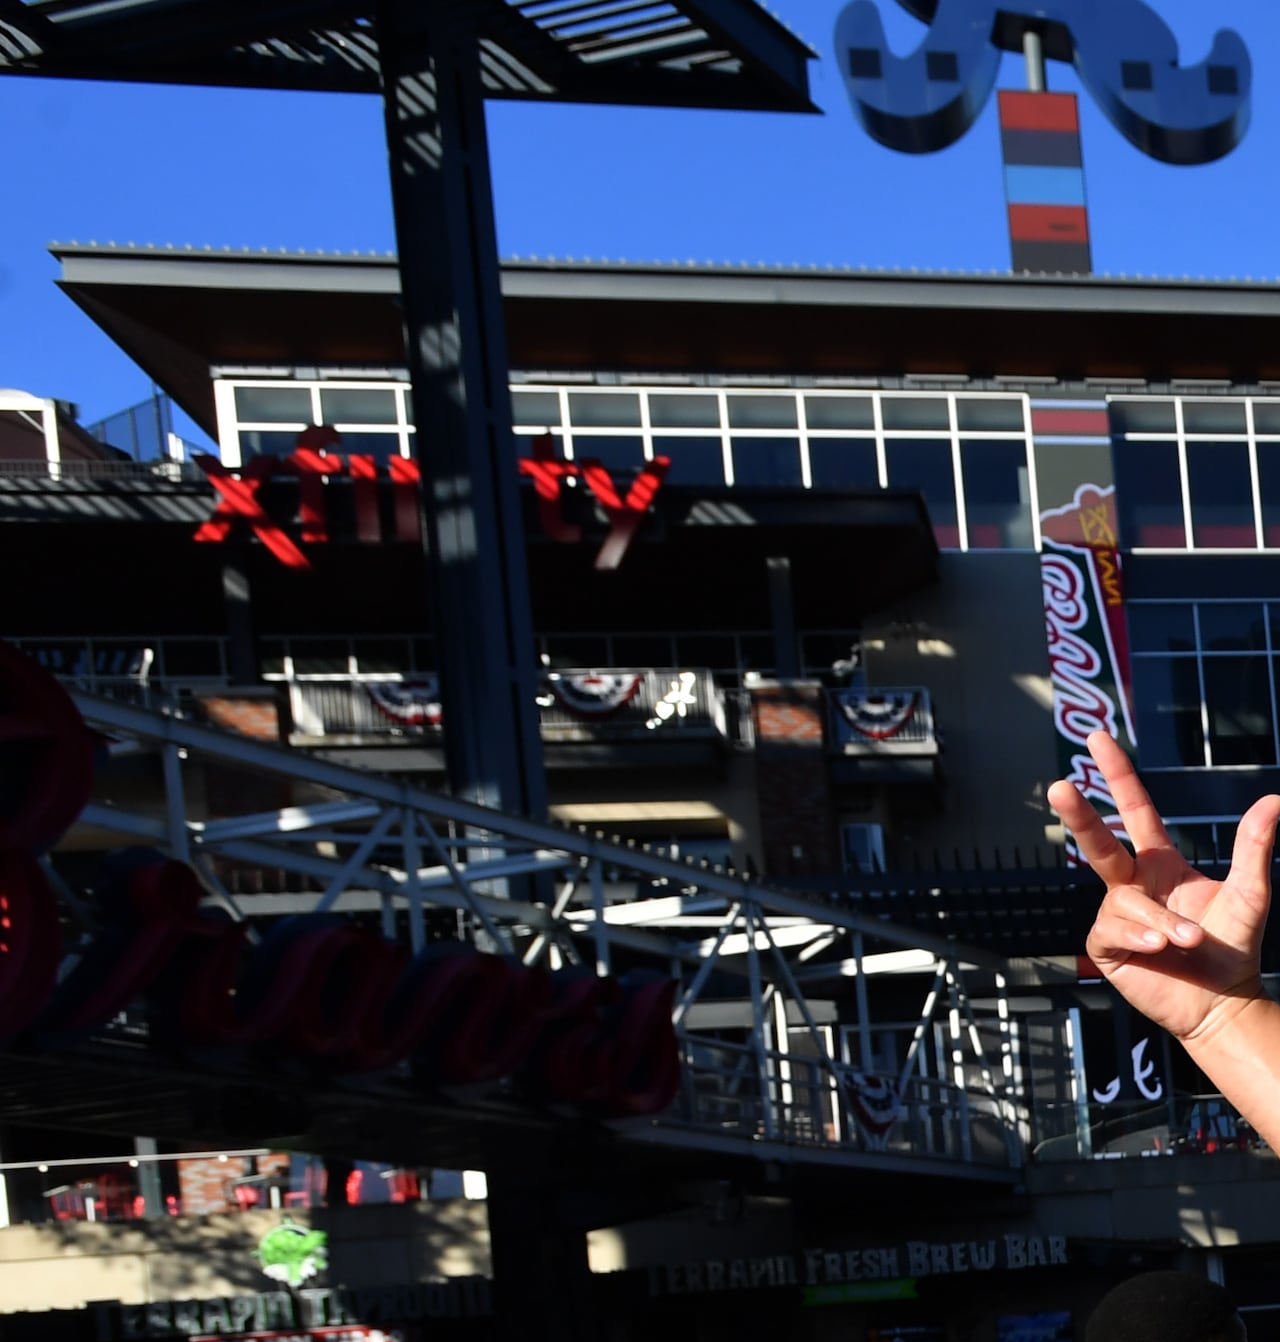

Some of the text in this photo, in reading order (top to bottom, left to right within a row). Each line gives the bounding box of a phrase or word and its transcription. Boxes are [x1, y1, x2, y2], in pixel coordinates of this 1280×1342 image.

[648, 1254, 799, 1296] TERRAPIN
[803, 1247, 900, 1285] FRESH
[906, 1239, 997, 1277] BREW
[1003, 1232, 1070, 1270] BAR
[94, 1290, 295, 1342] TERRAPIN
